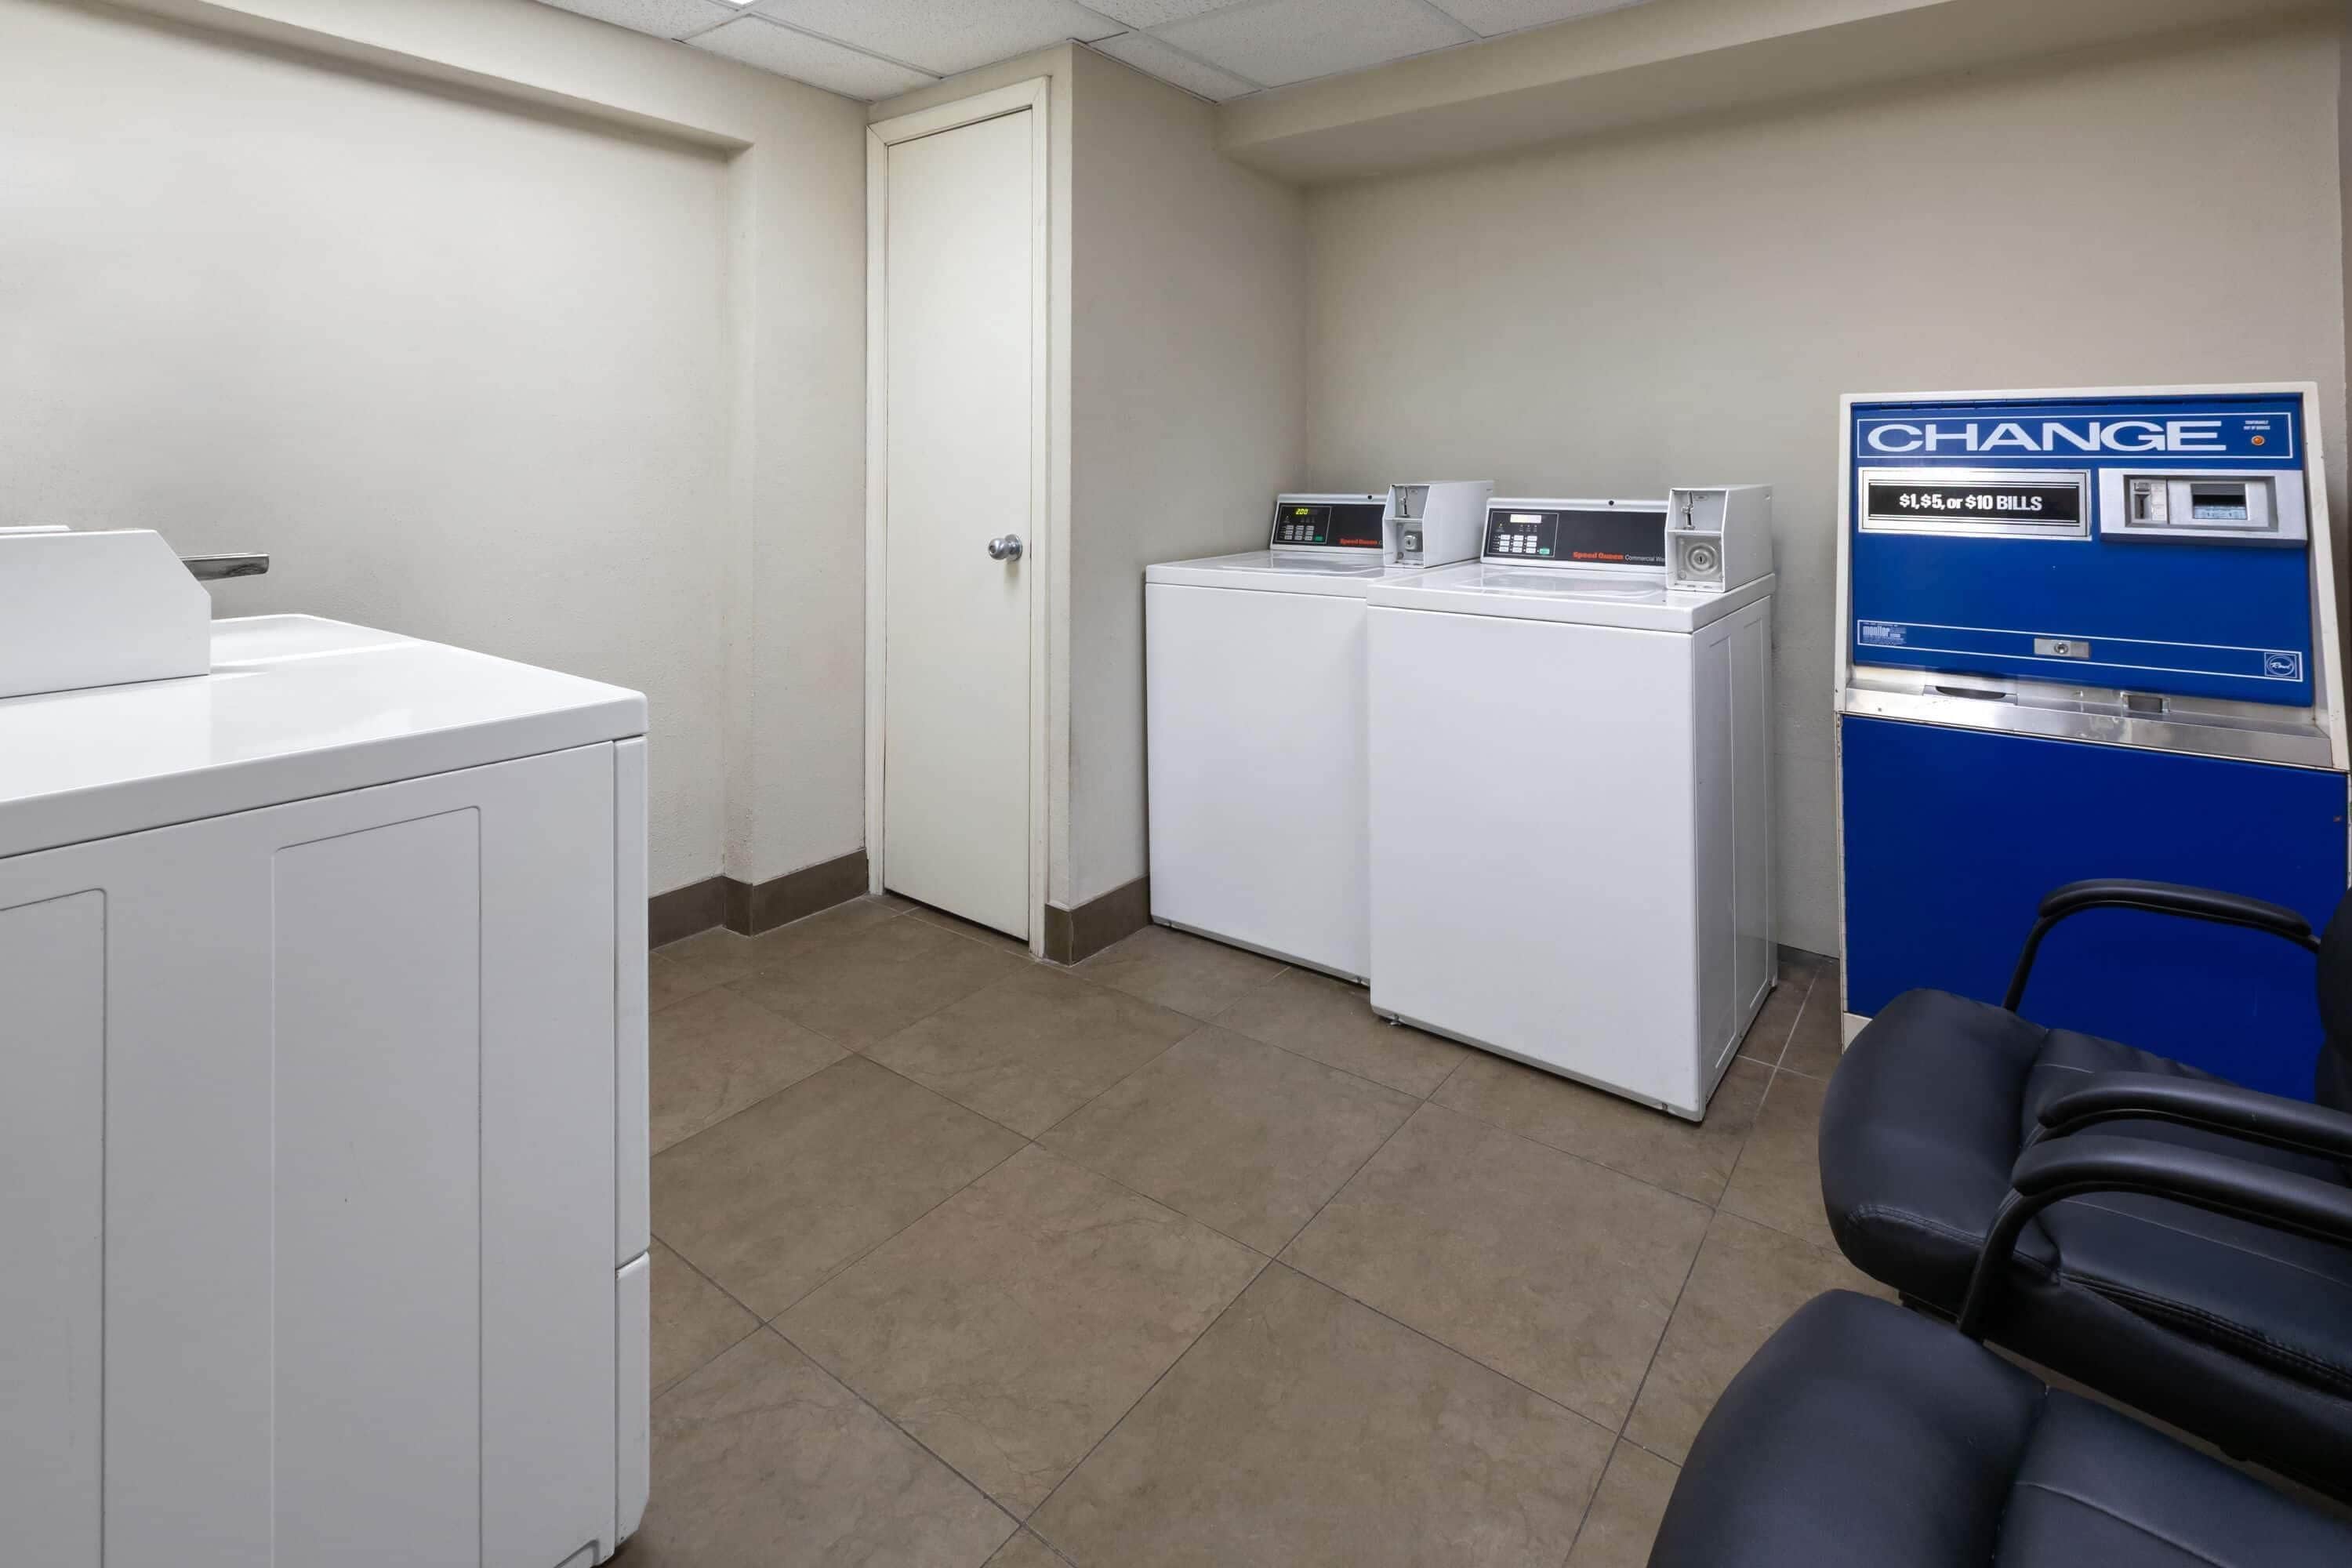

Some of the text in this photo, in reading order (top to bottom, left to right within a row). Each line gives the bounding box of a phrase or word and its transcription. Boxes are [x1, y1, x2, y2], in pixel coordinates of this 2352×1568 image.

[1867, 420, 2226, 452] CHANGE
[1946, 498, 1963, 509] or
[1965, 495, 1993, 510] $10
[1996, 495, 2042, 510] BILLS
